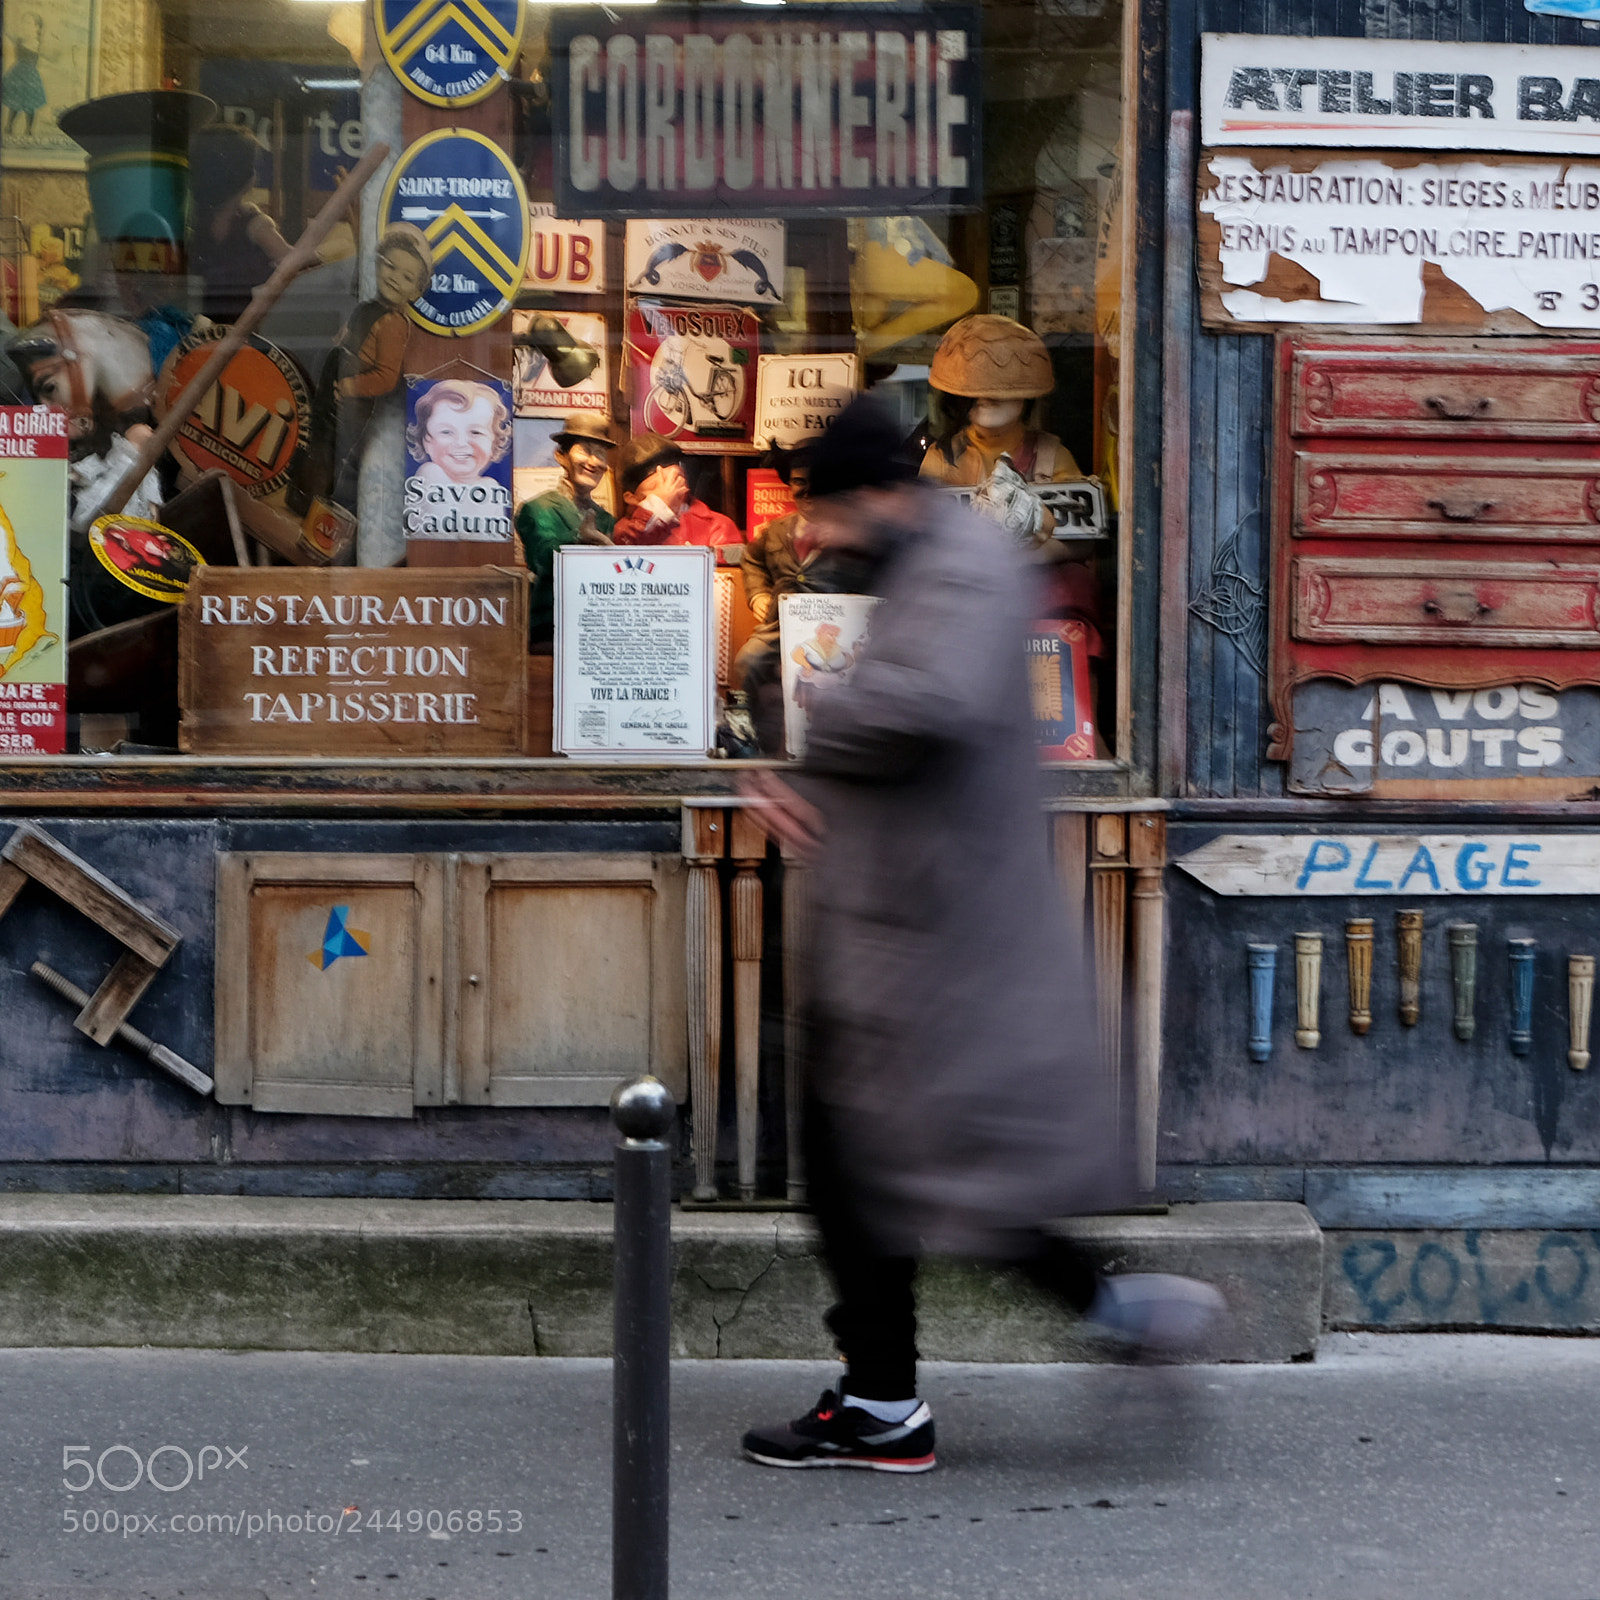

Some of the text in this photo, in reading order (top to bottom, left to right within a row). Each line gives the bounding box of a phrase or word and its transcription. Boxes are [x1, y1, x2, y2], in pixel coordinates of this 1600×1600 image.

[1223, 66, 1600, 122] ATELIER BA
[569, 30, 969, 192] CORDONNERIE
[399, 177, 514, 199] SAINT-TROPEZ
[1422, 179, 1507, 208] SIEGES
[1511, 189, 1525, 208] &
[1529, 181, 1600, 210] MEUB
[526, 232, 594, 283] UB
[1301, 238, 1325, 253] AU
[430, 273, 452, 293] 12
[1580, 283, 1600, 311] 3
[787, 368, 824, 389] ICI
[571, 392, 605, 408] NOIR
[13, 412, 67, 437] GIRAFE
[404, 476, 513, 508] Savon
[402, 507, 514, 538] Cadum
[589, 583, 615, 595] TOUS
[619, 583, 636, 595] LES
[641, 583, 690, 597] FRANÇAIS
[200, 595, 507, 626] RESTAURATION
[250, 645, 468, 677] REFECTION
[243, 692, 480, 725] TAPISSERIE
[591, 688, 613, 700] VIVE
[616, 688, 629, 700] LA
[631, 688, 669, 700] FRANCE
[1361, 683, 1559, 720] A VOS
[21, 712, 54, 726] COU
[1333, 727, 1563, 767] GOUTS
[1296, 839, 1542, 891] PLAGE
